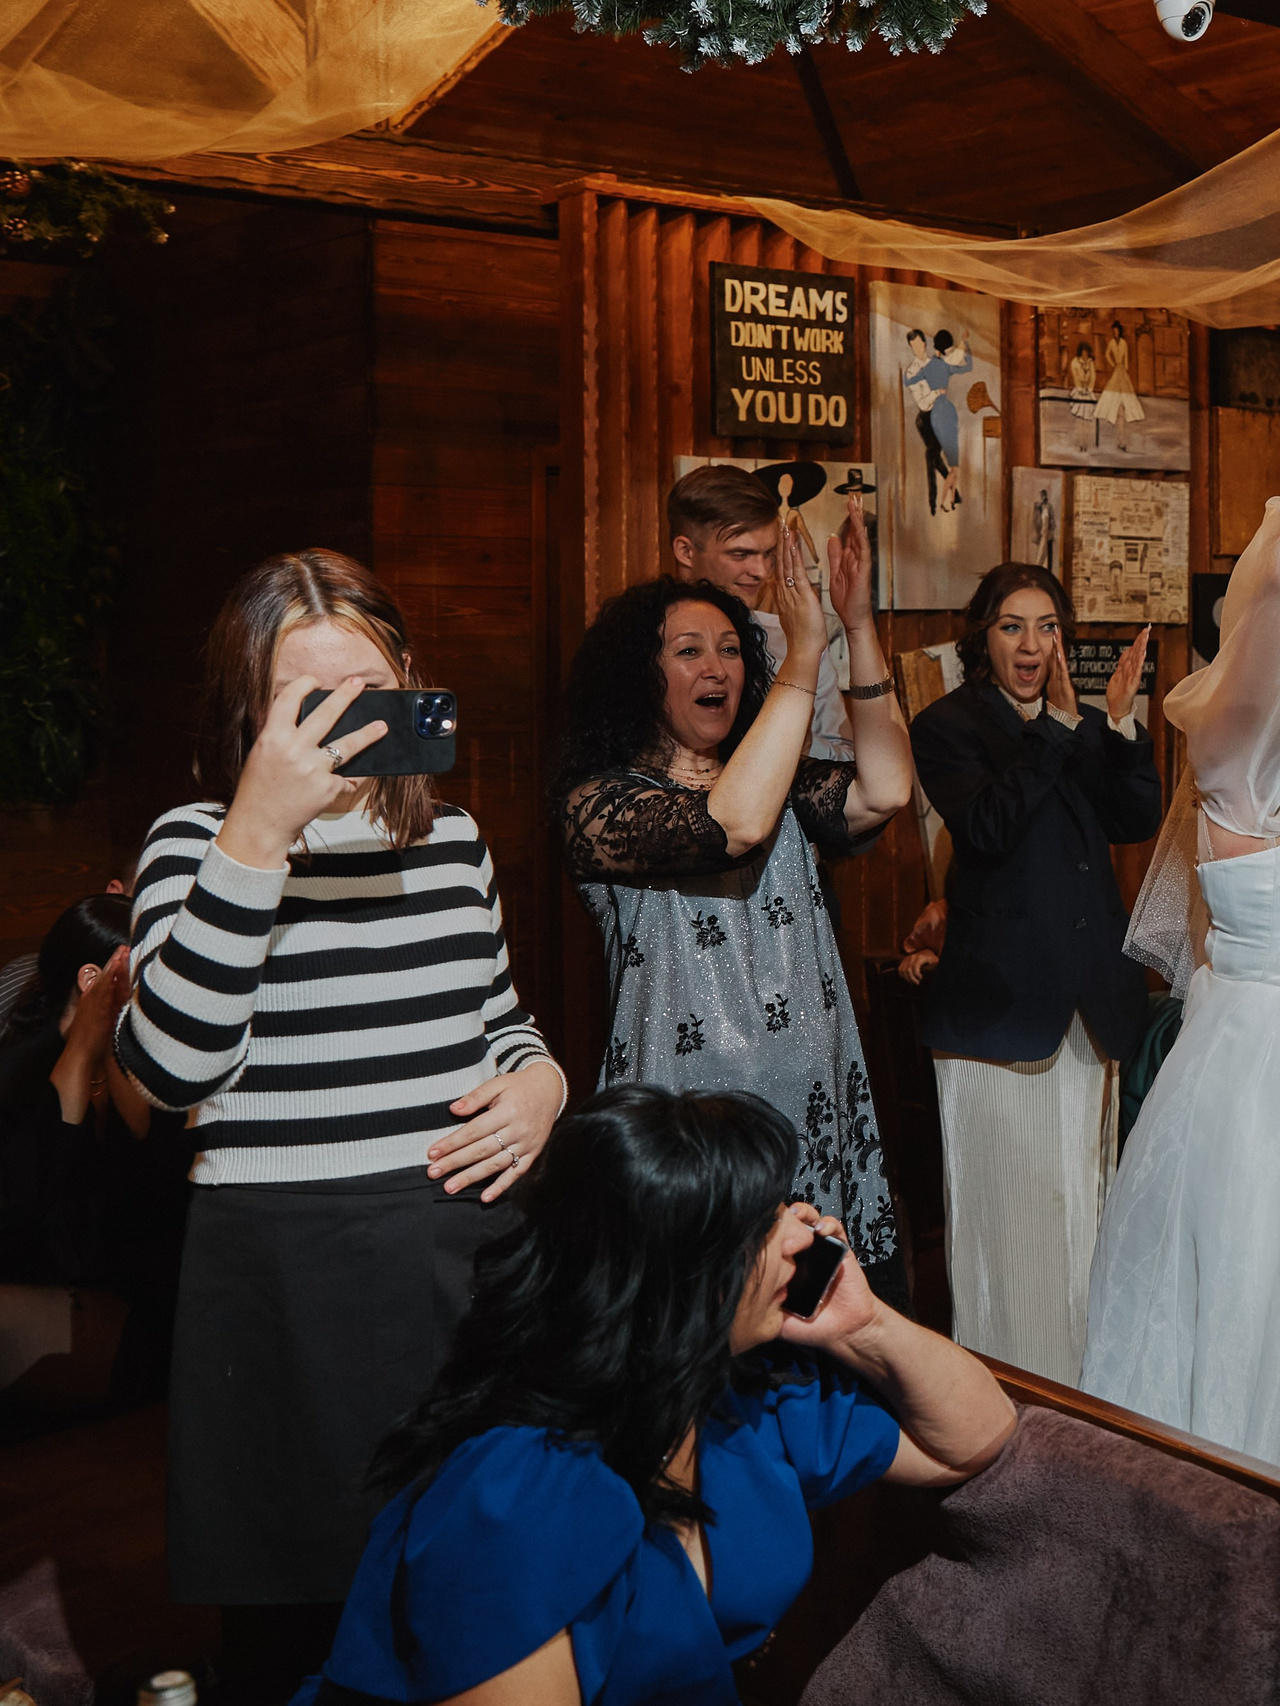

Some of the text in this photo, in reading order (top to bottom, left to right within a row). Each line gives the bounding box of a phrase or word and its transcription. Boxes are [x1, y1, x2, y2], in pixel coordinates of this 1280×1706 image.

[724, 278, 848, 323] DREAMS
[730, 321, 844, 354] DON'T WORK
[741, 356, 822, 385] UNLESS
[730, 388, 847, 428] YOU DO
